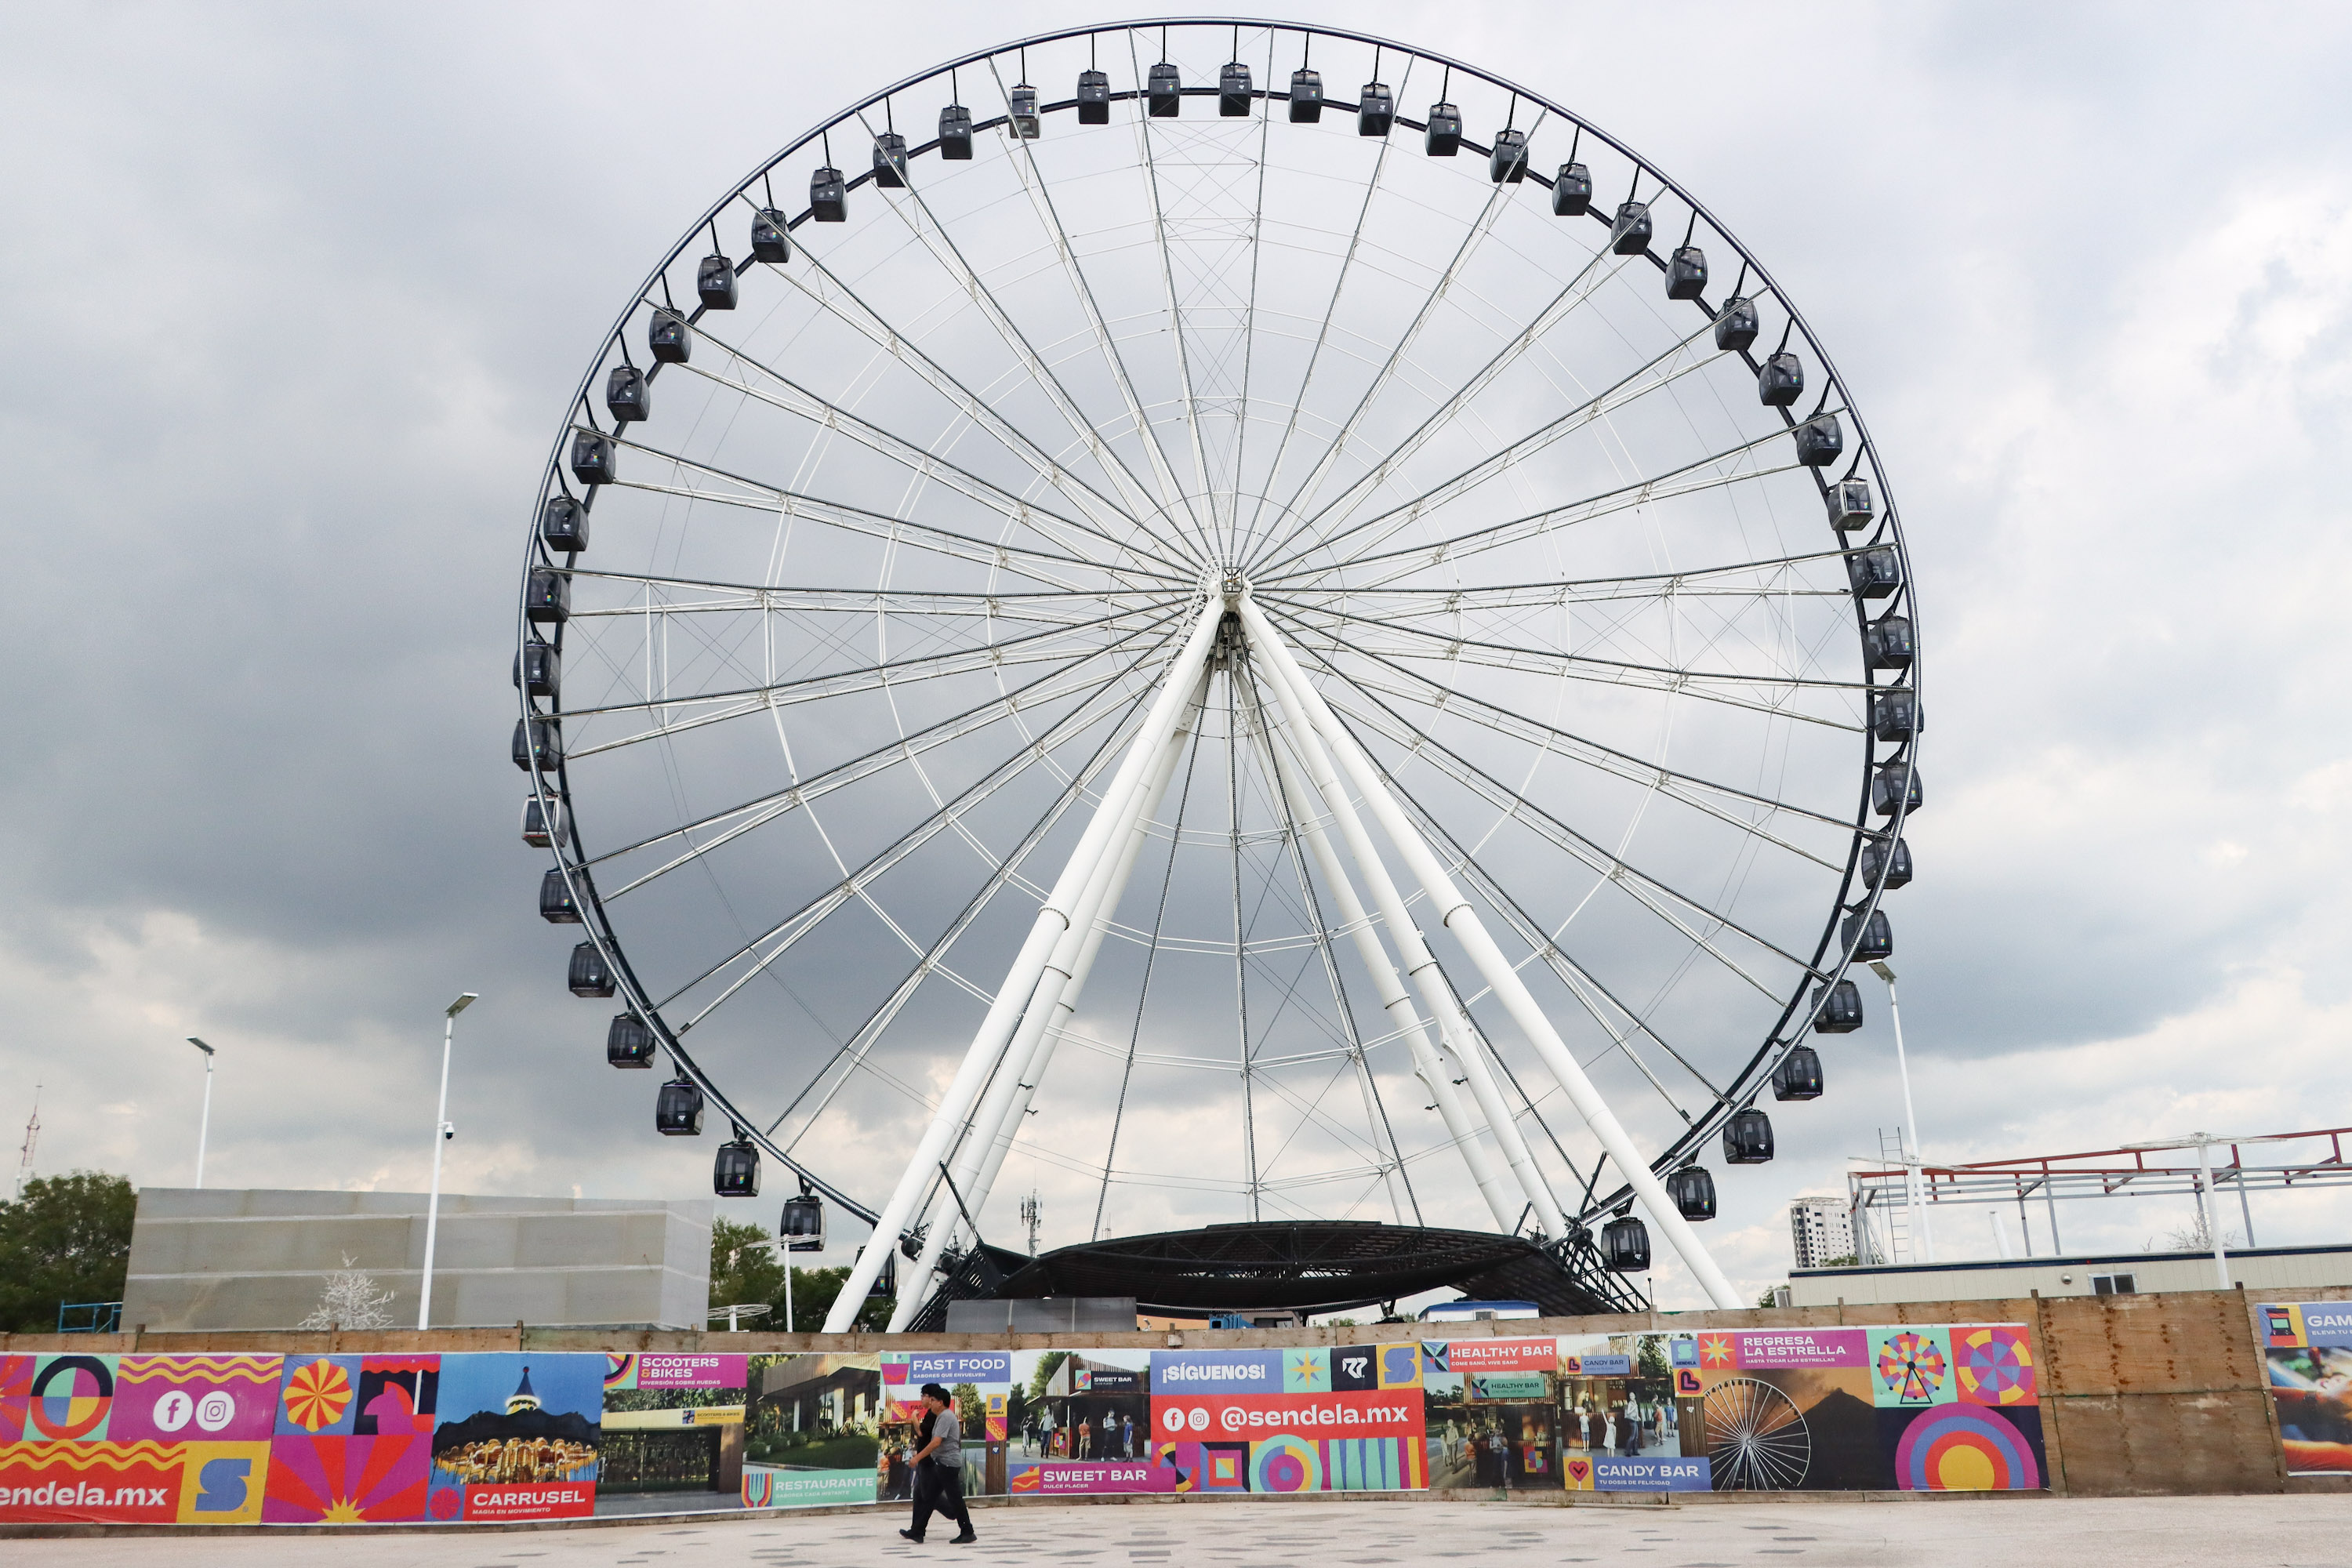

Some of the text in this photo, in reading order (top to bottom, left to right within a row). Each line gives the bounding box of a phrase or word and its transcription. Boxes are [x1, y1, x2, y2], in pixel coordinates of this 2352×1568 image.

[1743, 1336, 1814, 1346] REGRESA
[1451, 1346, 1552, 1358] HEALTHY BAR
[1744, 1345, 1846, 1356] LA ESTRELLA
[641, 1358, 719, 1367] SCOOTERS
[913, 1359, 1005, 1370] FAST FOOD
[1163, 1363, 1265, 1383] ¡SÍGUENOS!
[1221, 1404, 1409, 1432] @sendela.mx
[1044, 1470, 1146, 1482] SWEET BAR
[1598, 1465, 1699, 1477] CANDY BAR
[775, 1478, 874, 1490] RESTAURANTE
[473, 1490, 586, 1506] CARRUSEL
